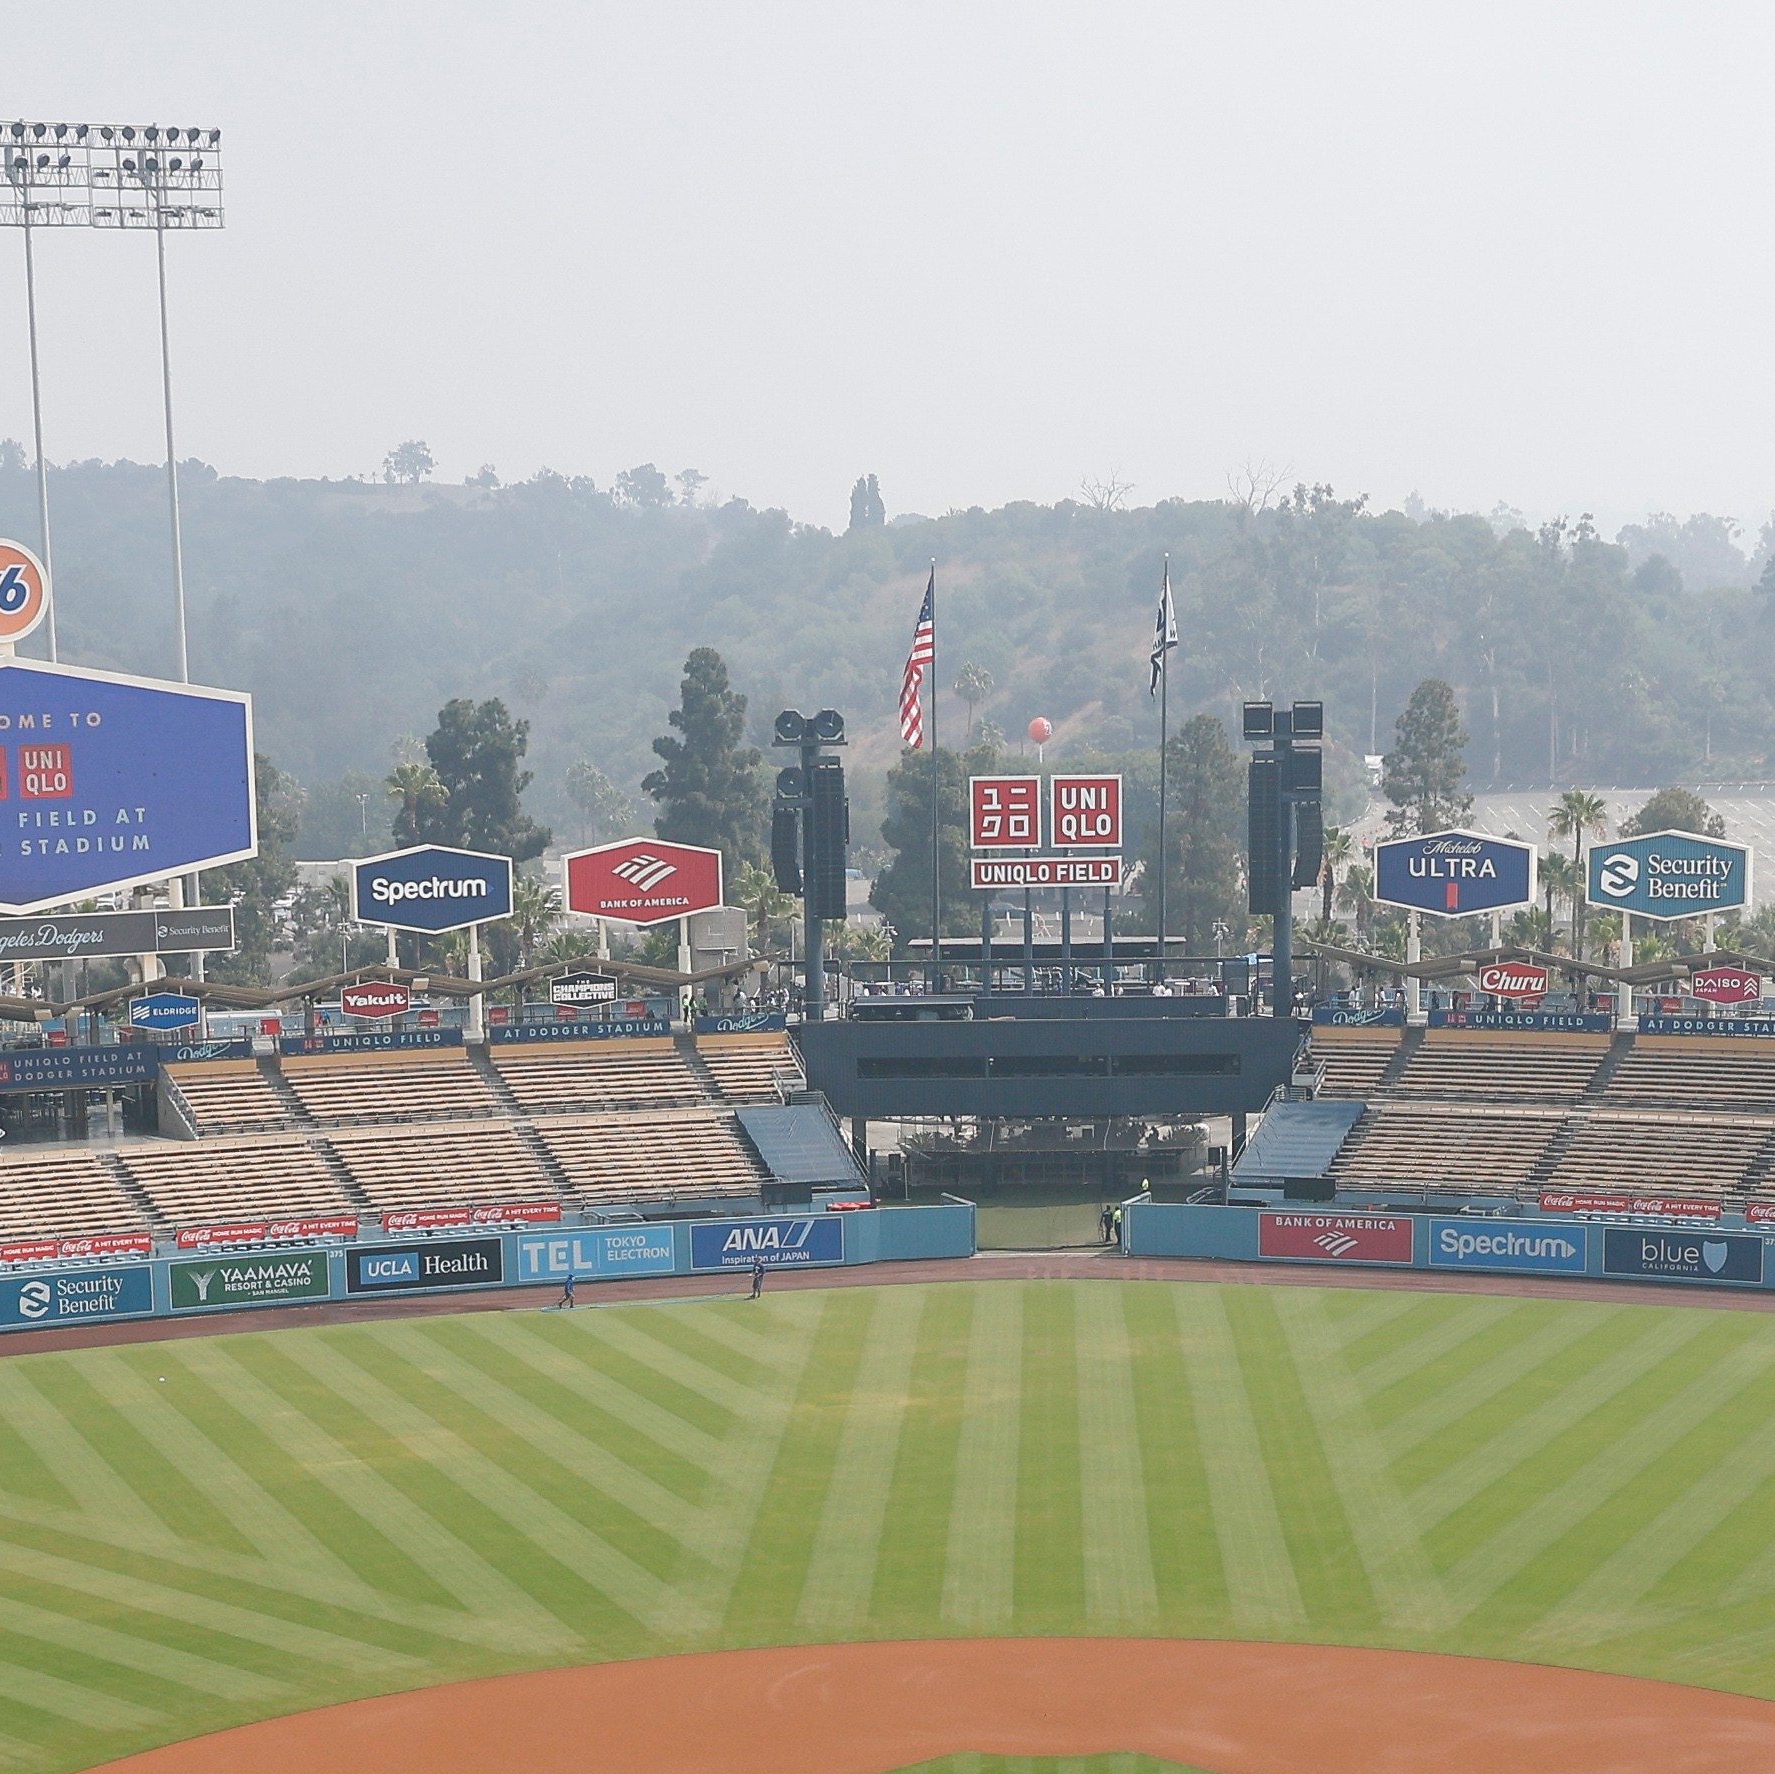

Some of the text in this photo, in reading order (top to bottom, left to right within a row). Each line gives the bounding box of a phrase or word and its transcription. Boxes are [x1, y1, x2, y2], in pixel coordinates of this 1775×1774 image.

[70, 711, 102, 728] TO
[25, 750, 63, 770] UNI
[26, 772, 67, 795] QLO
[1061, 786, 1107, 809] UNI
[18, 809, 97, 828] FIELD
[115, 807, 148, 825] AT
[1061, 814, 1112, 841] QLO
[21, 834, 151, 856] STADIUM
[1422, 840, 1482, 856] Michelob
[980, 862, 1113, 884] UNIQLO FIELD
[1408, 858, 1497, 879] ULTRA
[1647, 854, 1733, 879] Security
[372, 876, 487, 902] Spectrum
[1647, 876, 1721, 899] Benefit
[600, 896, 690, 909] BANK OF AMERICA
[33, 924, 105, 956] Dodgers
[169, 925, 229, 938] Security Benefit
[552, 982, 614, 993] CHAMPIONS
[1482, 969, 1545, 991] Churu
[1695, 977, 1741, 988] DAISO
[345, 994, 406, 1007] Yakult
[552, 990, 615, 1002] COLLECTIVE
[153, 1005, 197, 1017] ELDRIDGE
[1275, 1217, 1396, 1231] BANK OF AMERICA
[605, 1235, 646, 1248] TOKYO
[722, 1226, 781, 1252] ANA
[1440, 1229, 1568, 1260] Spectrum
[329, 1250, 344, 1259] 375
[523, 1240, 593, 1274] TEL
[607, 1247, 669, 1262] ELECTRON
[769, 1253, 780, 1261] of
[780, 1251, 810, 1262] JAPAN
[1642, 1237, 1700, 1265] blue
[368, 1252, 489, 1277] UCLA Health
[1642, 1264, 1699, 1273] CALIFORNIA
[57, 1276, 123, 1296] Security
[224, 1277, 311, 1292] RESORT & CASINO
[58, 1294, 115, 1315] Benefit
